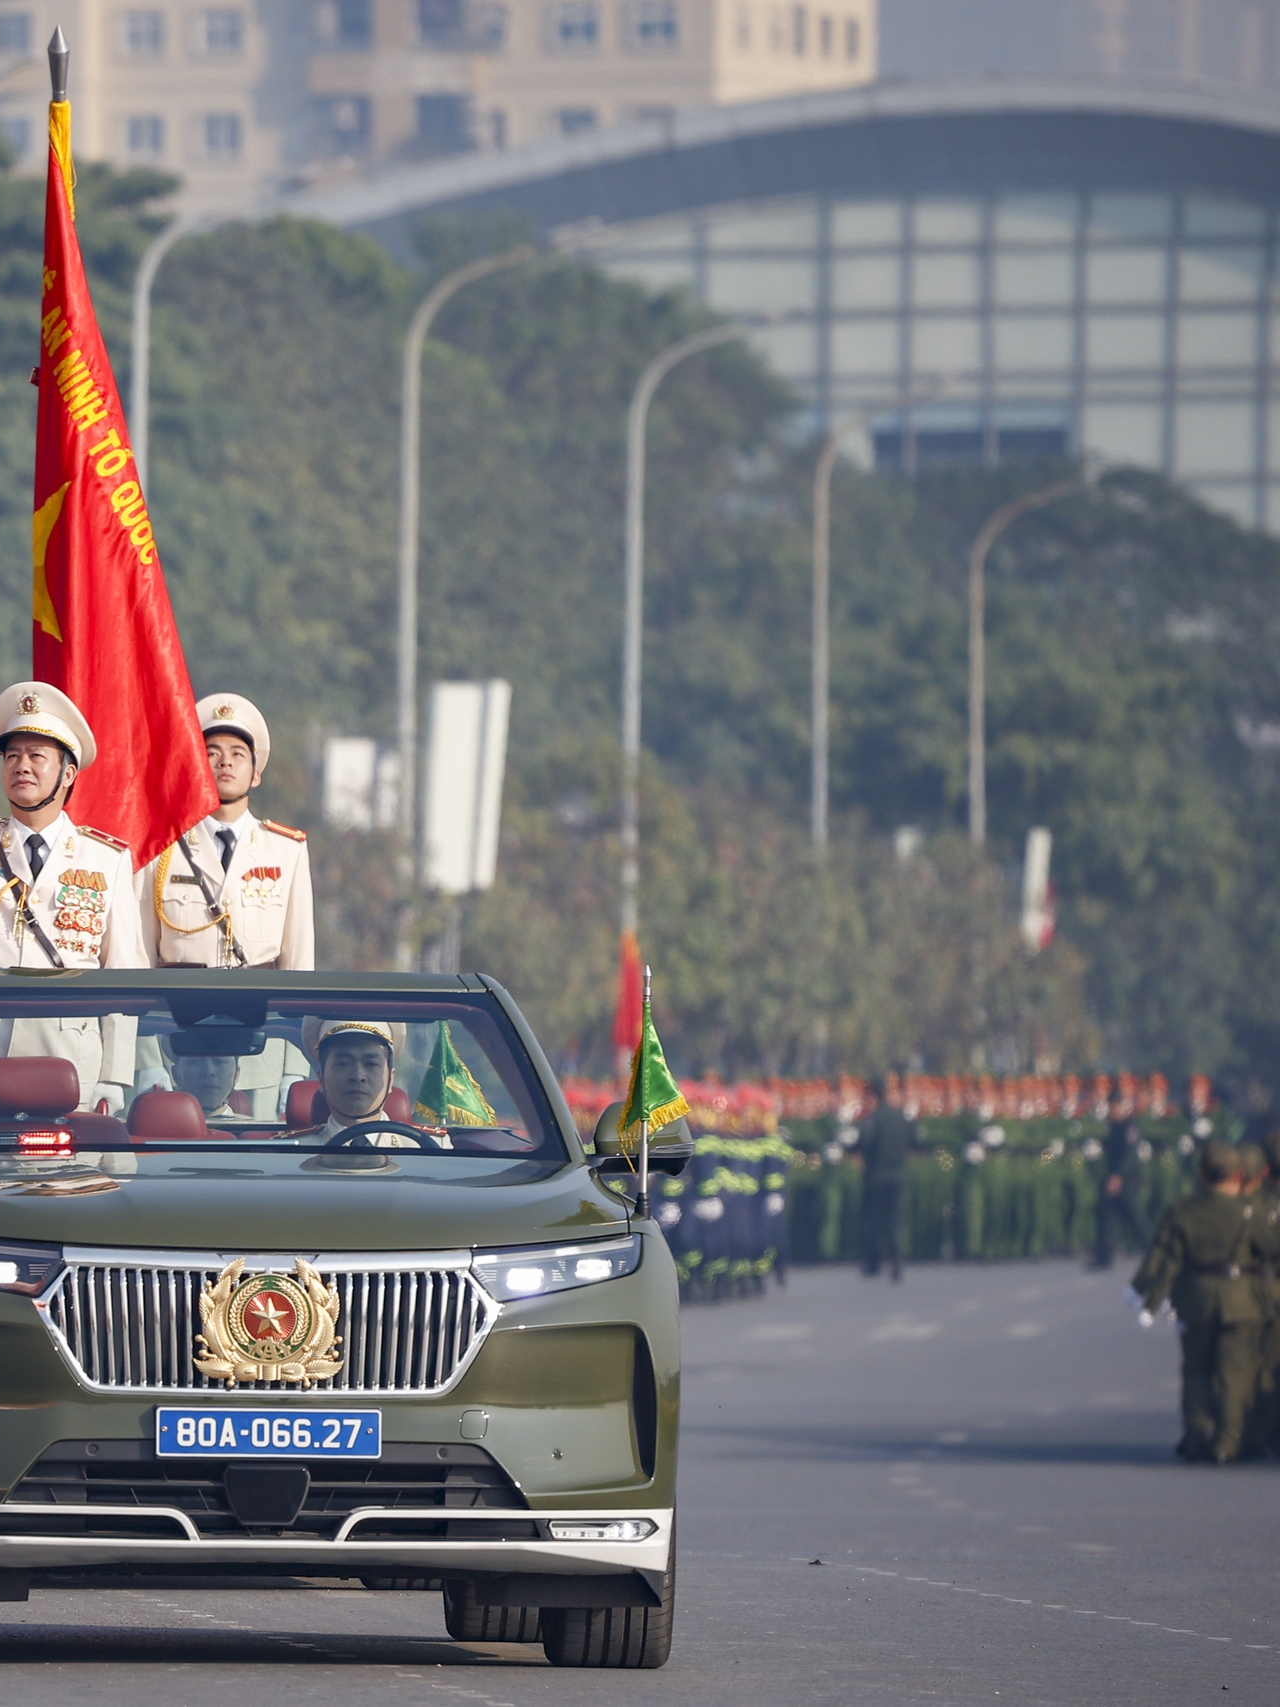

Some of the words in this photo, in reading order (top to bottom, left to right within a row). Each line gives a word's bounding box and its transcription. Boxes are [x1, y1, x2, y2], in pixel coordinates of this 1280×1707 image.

[42, 305, 73, 358] AN
[53, 349, 109, 432] NINH
[176, 1417, 362, 1449] 80A-066.27
